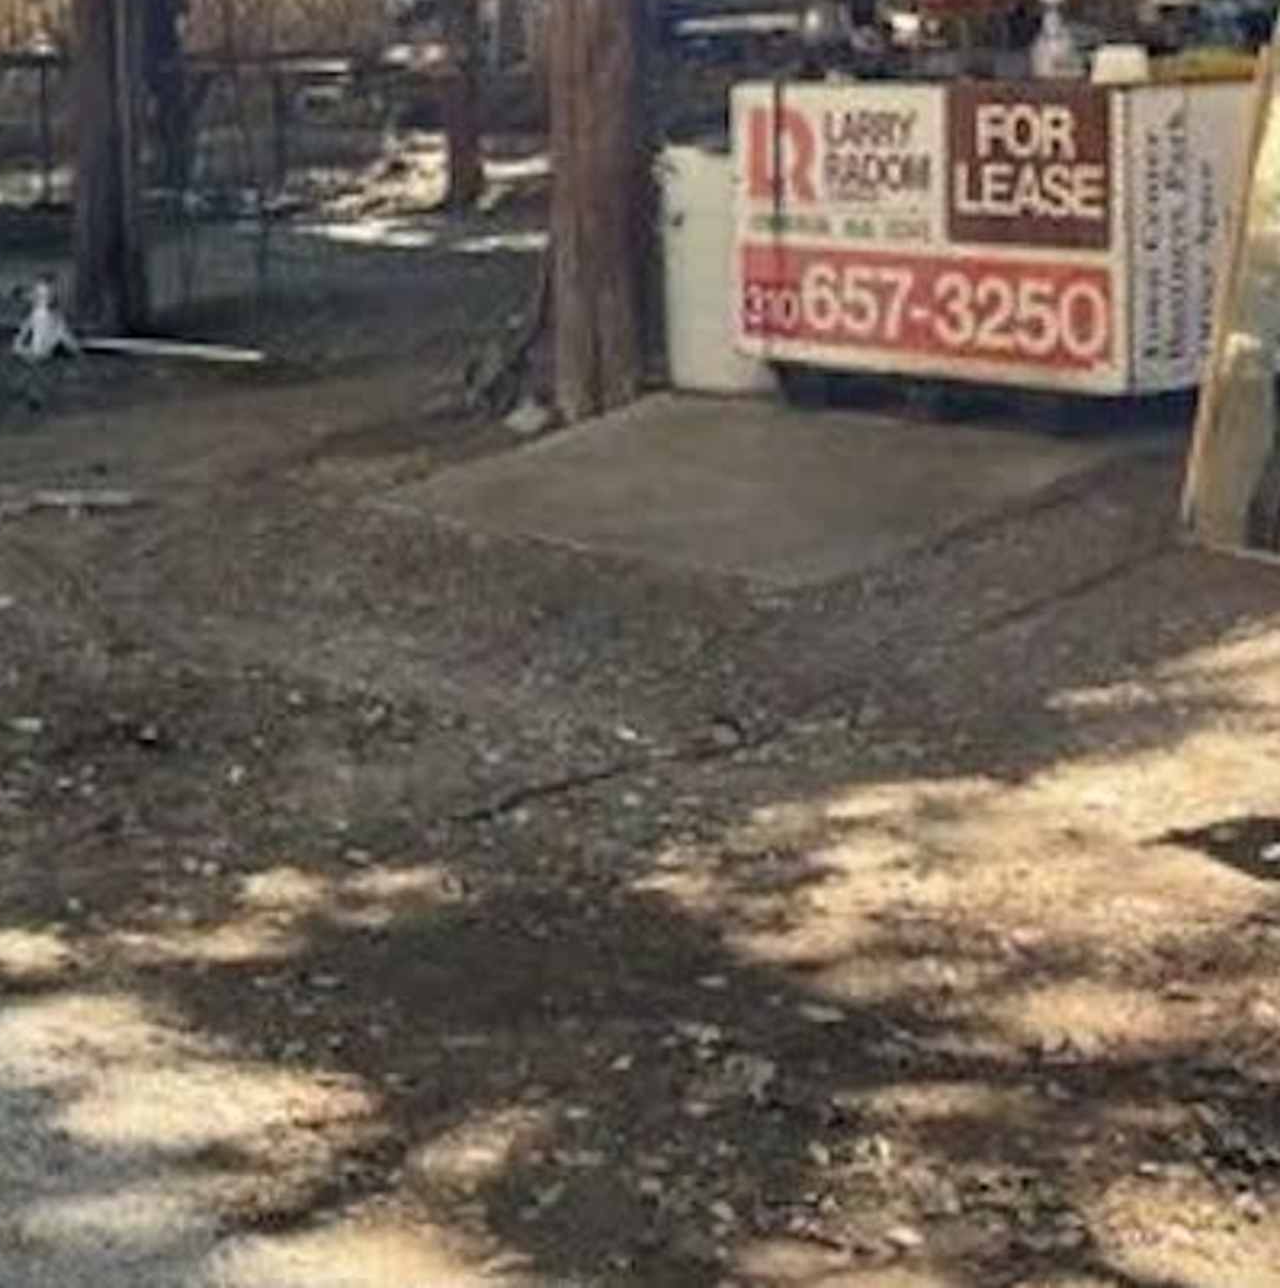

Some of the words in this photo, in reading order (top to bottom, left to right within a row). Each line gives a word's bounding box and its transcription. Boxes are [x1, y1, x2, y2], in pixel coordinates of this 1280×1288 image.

[823, 110, 917, 146] LARRY
[976, 104, 1074, 159] FOR
[954, 162, 1106, 218] LEASE
[800, 262, 1106, 357] 657-3250
